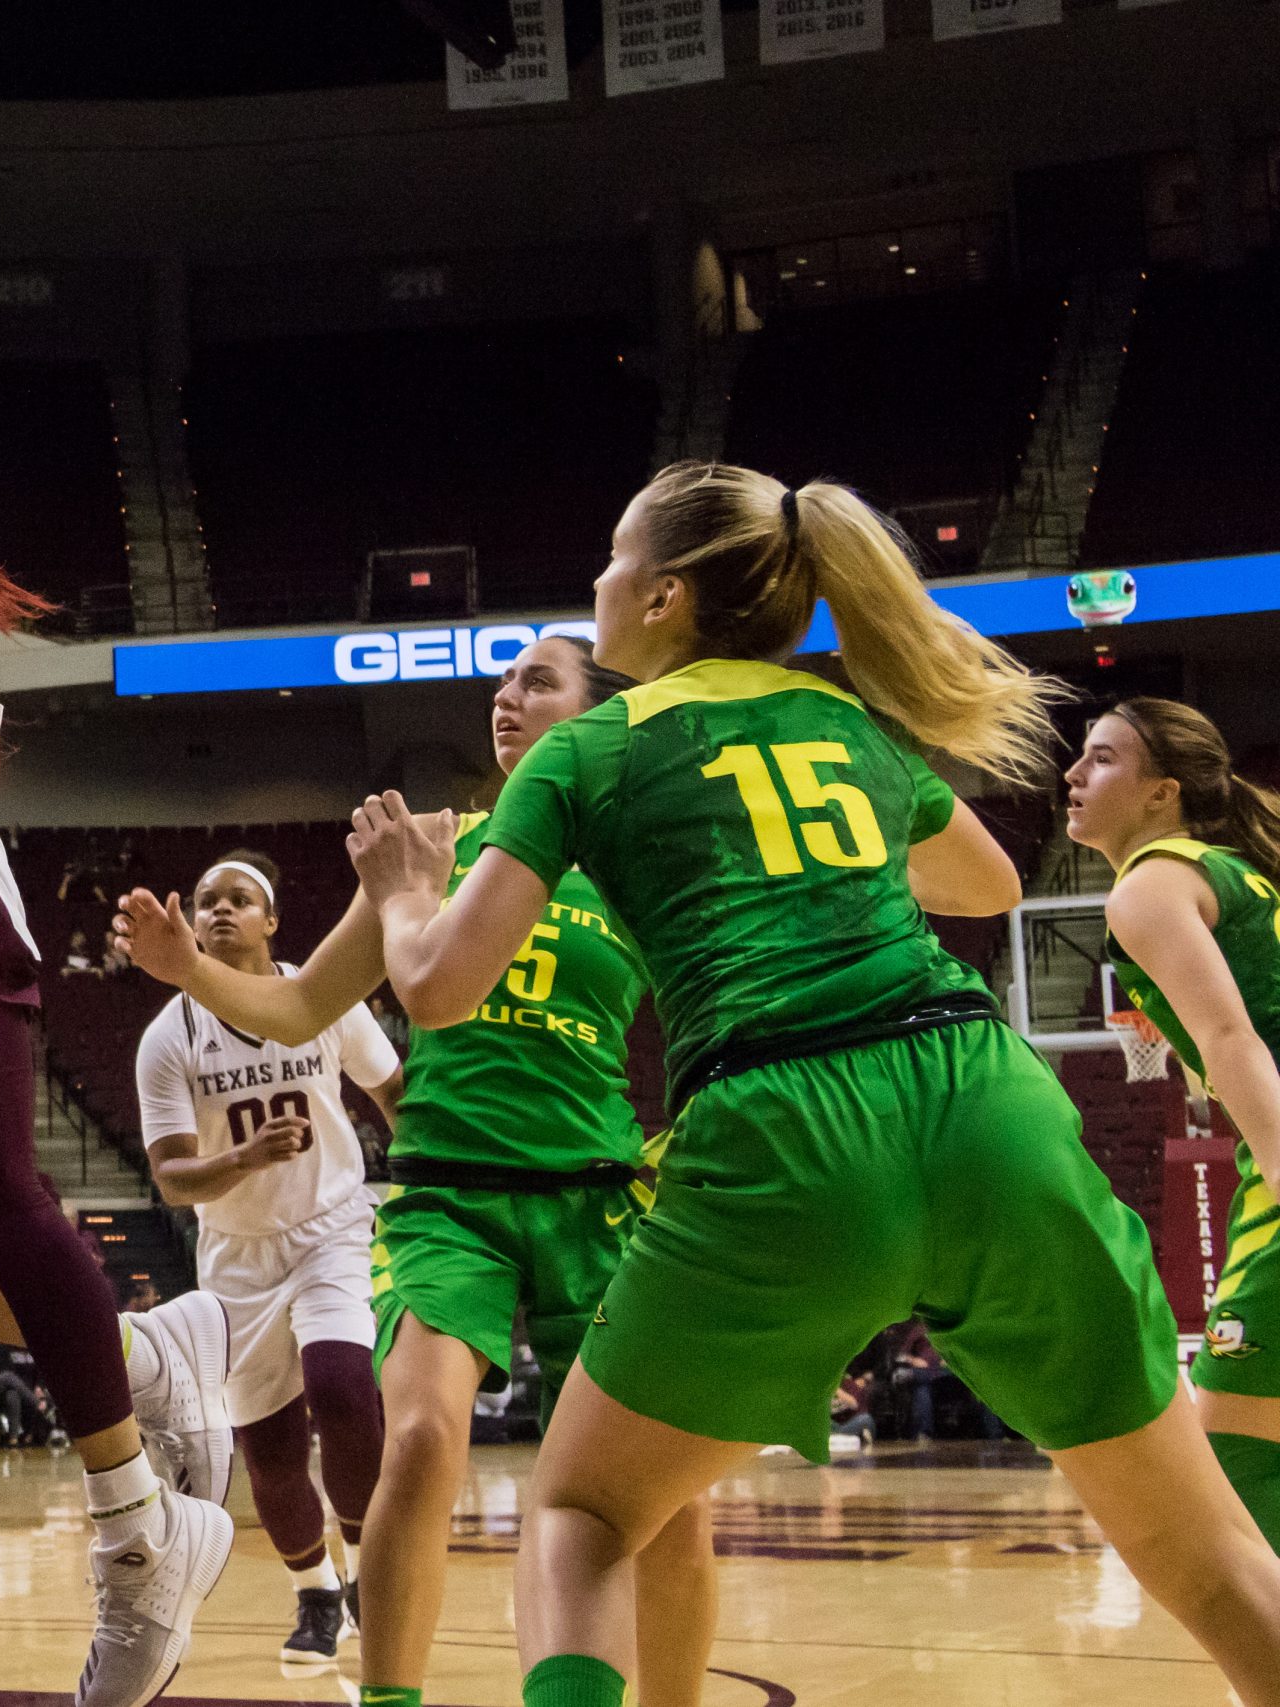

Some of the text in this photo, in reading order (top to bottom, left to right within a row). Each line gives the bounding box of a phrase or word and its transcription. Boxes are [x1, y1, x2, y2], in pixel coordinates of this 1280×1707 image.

[700, 740, 888, 876] 15
[506, 922, 562, 1003] 5
[466, 1003, 599, 1045] UCKS
[196, 1054, 325, 1097] TEXAS A&M
[1193, 1162, 1213, 1257] TEXAS
